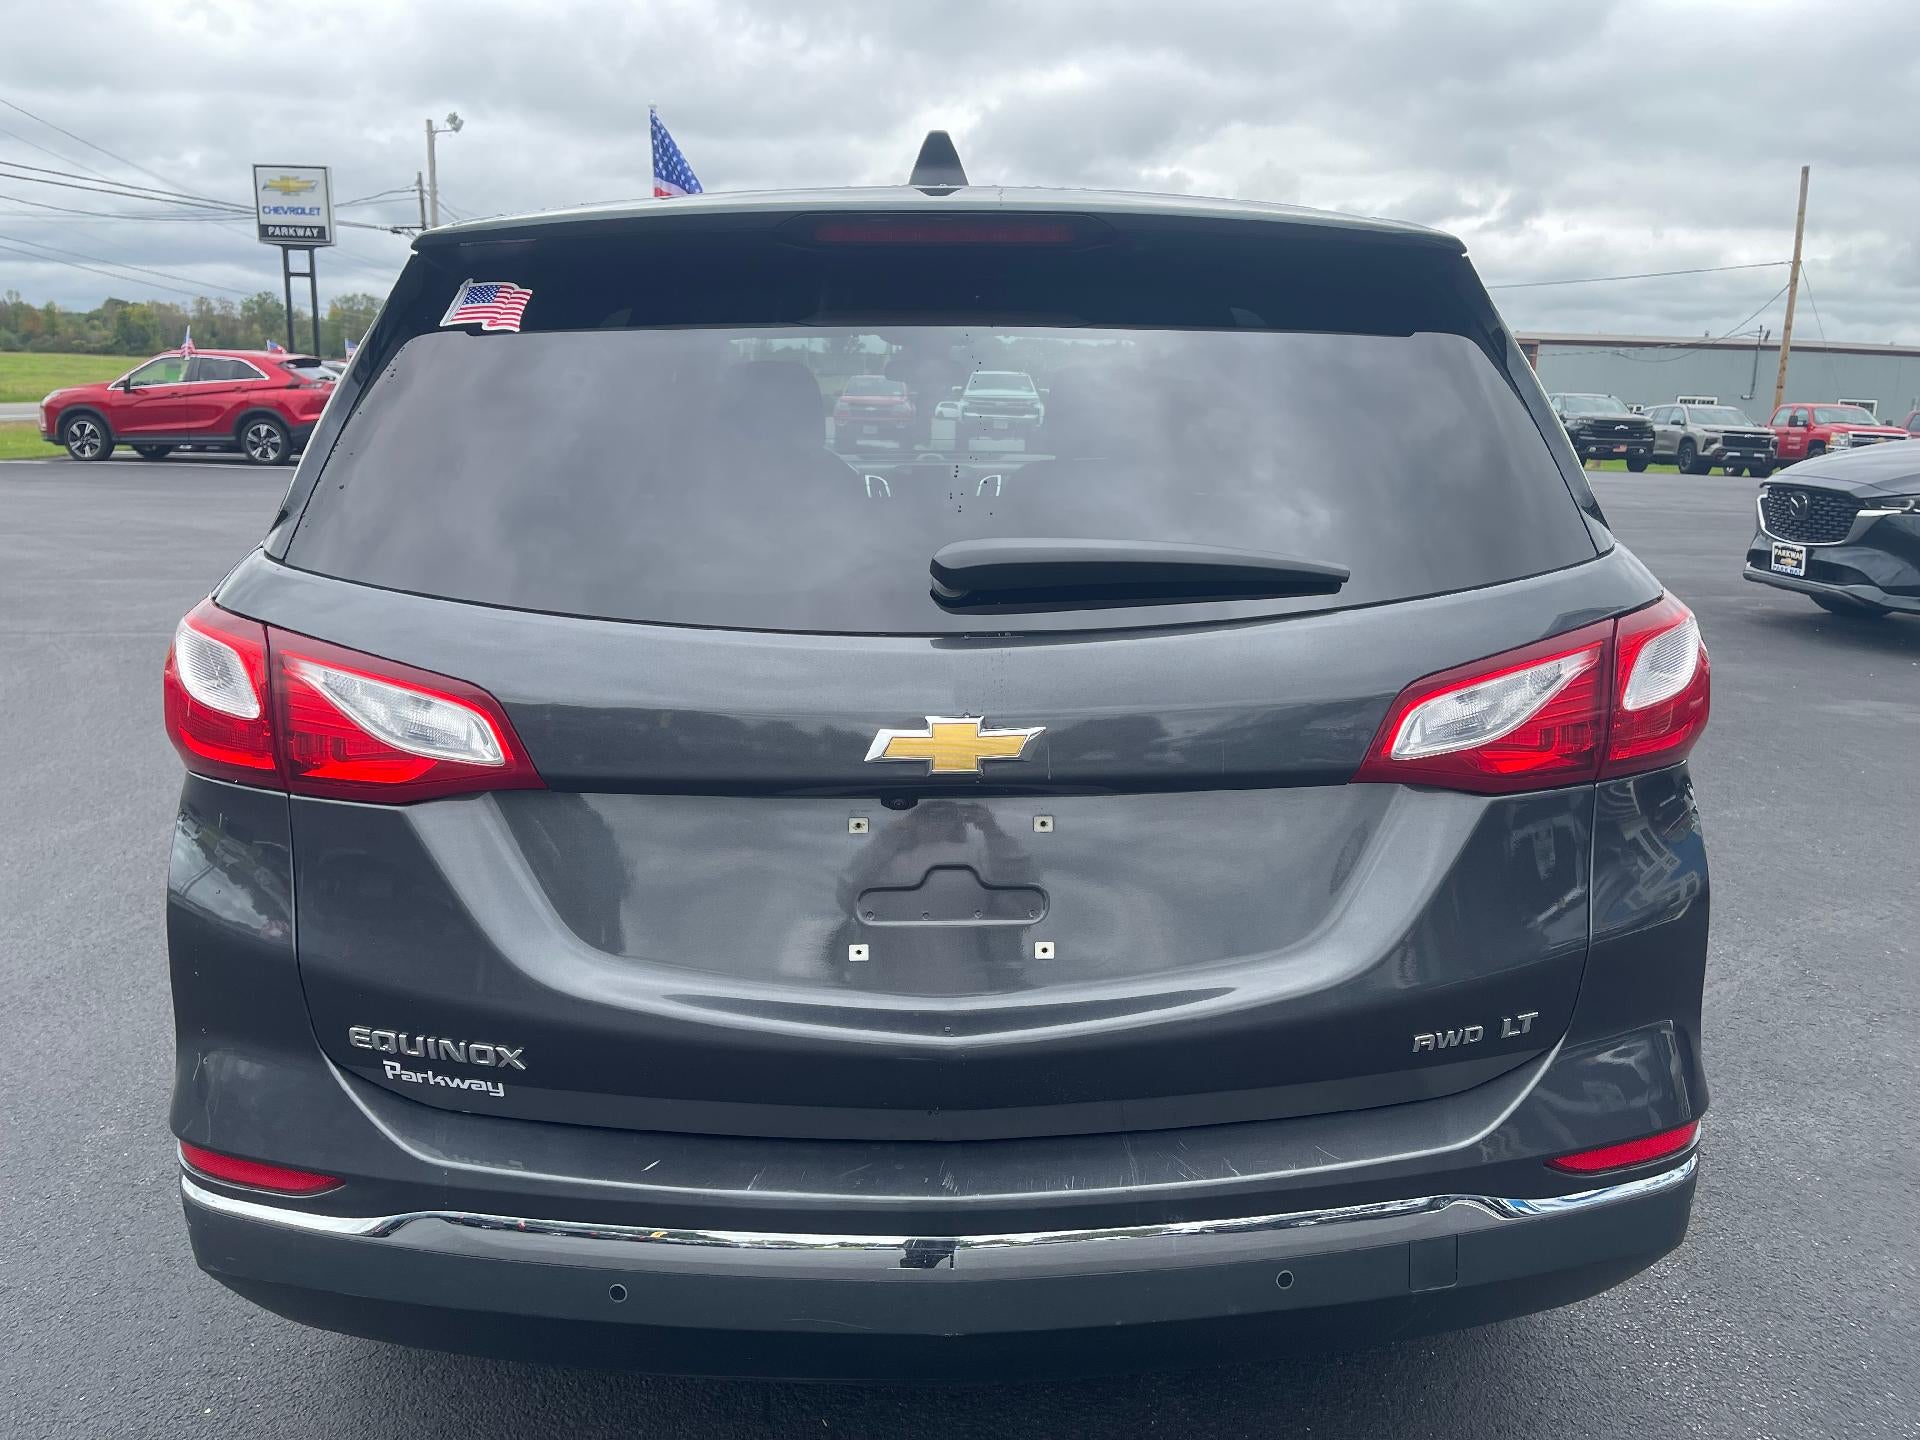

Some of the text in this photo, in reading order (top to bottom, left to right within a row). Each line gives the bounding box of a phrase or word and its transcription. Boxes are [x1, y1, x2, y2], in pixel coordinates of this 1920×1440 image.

[262, 206, 321, 216] CHEVROLET
[267, 226, 319, 237] PARKWAY
[348, 1025, 527, 1070] EQUINOX
[1412, 1011, 1539, 1053] AWD LT
[382, 1059, 505, 1097] Parkway
